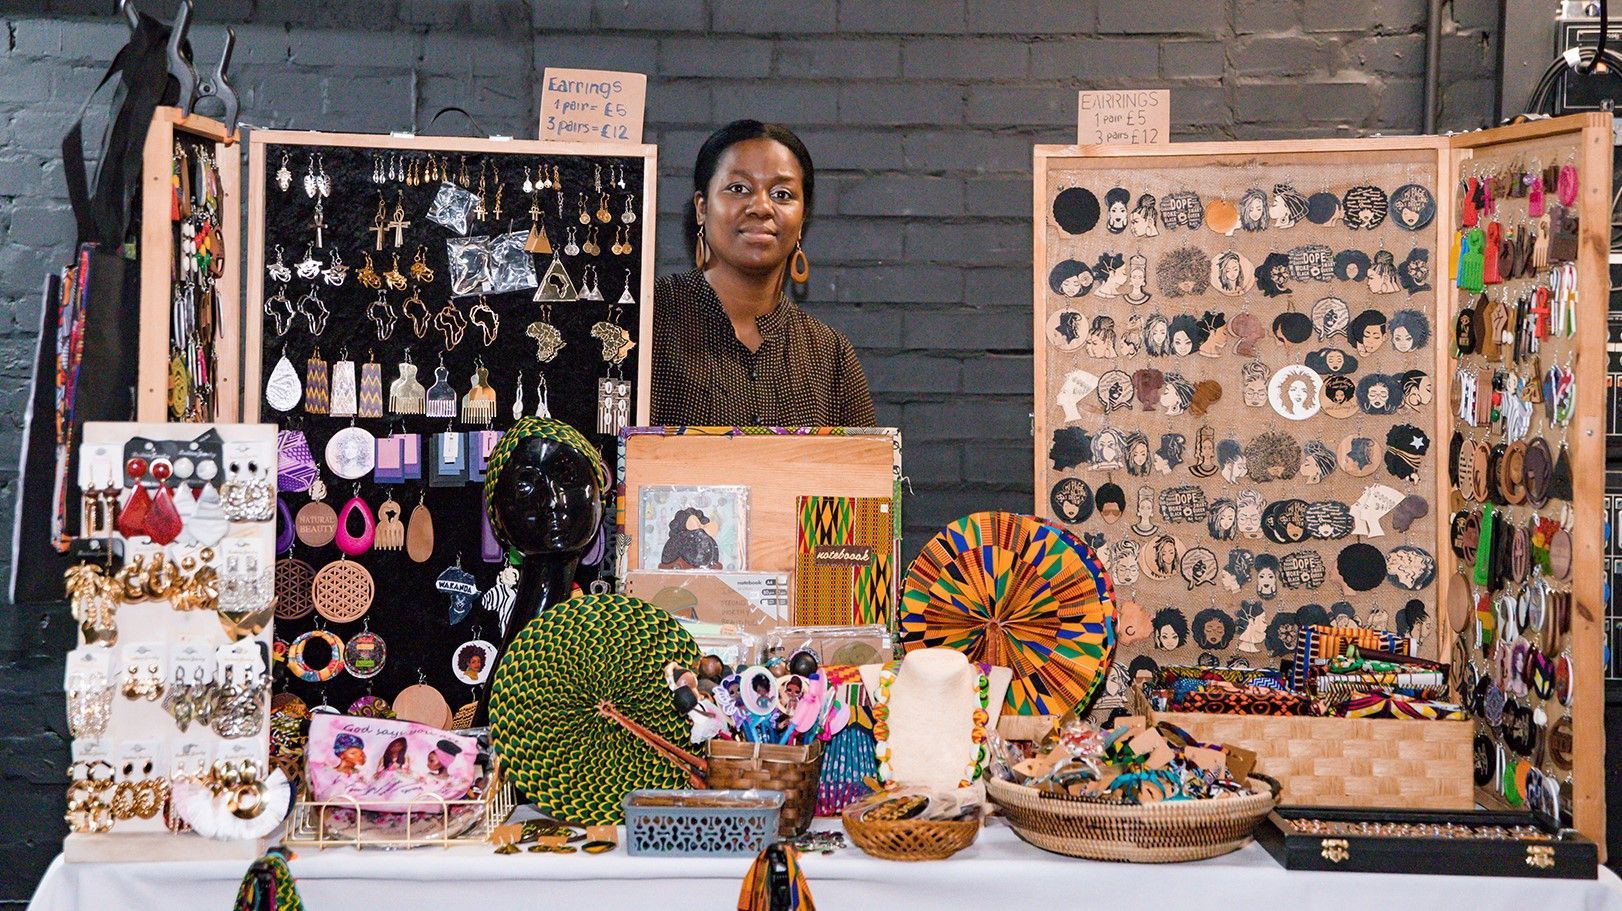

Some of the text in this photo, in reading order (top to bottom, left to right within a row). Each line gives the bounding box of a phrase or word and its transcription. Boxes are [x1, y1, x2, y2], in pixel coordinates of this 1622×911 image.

[548, 77, 622, 99] Earrings
[554, 99, 560, 110] 1
[1081, 91, 1159, 110] EARRINGS
[1094, 110, 1146, 127] 1 pair £5
[547, 116, 555, 130] 3
[600, 123, 629, 140] £12
[1095, 128, 1159, 145] 3 pairs £12
[1170, 198, 1193, 210] DOPE
[1303, 252, 1326, 264] DOPE
[1175, 492, 1198, 504] DOPE
[300, 515, 335, 523] NATURAL
[300, 524, 335, 533] BEAUTY
[1292, 557, 1315, 569] DOPE
[438, 581, 472, 593] WAKANDA
[342, 724, 373, 734] God
